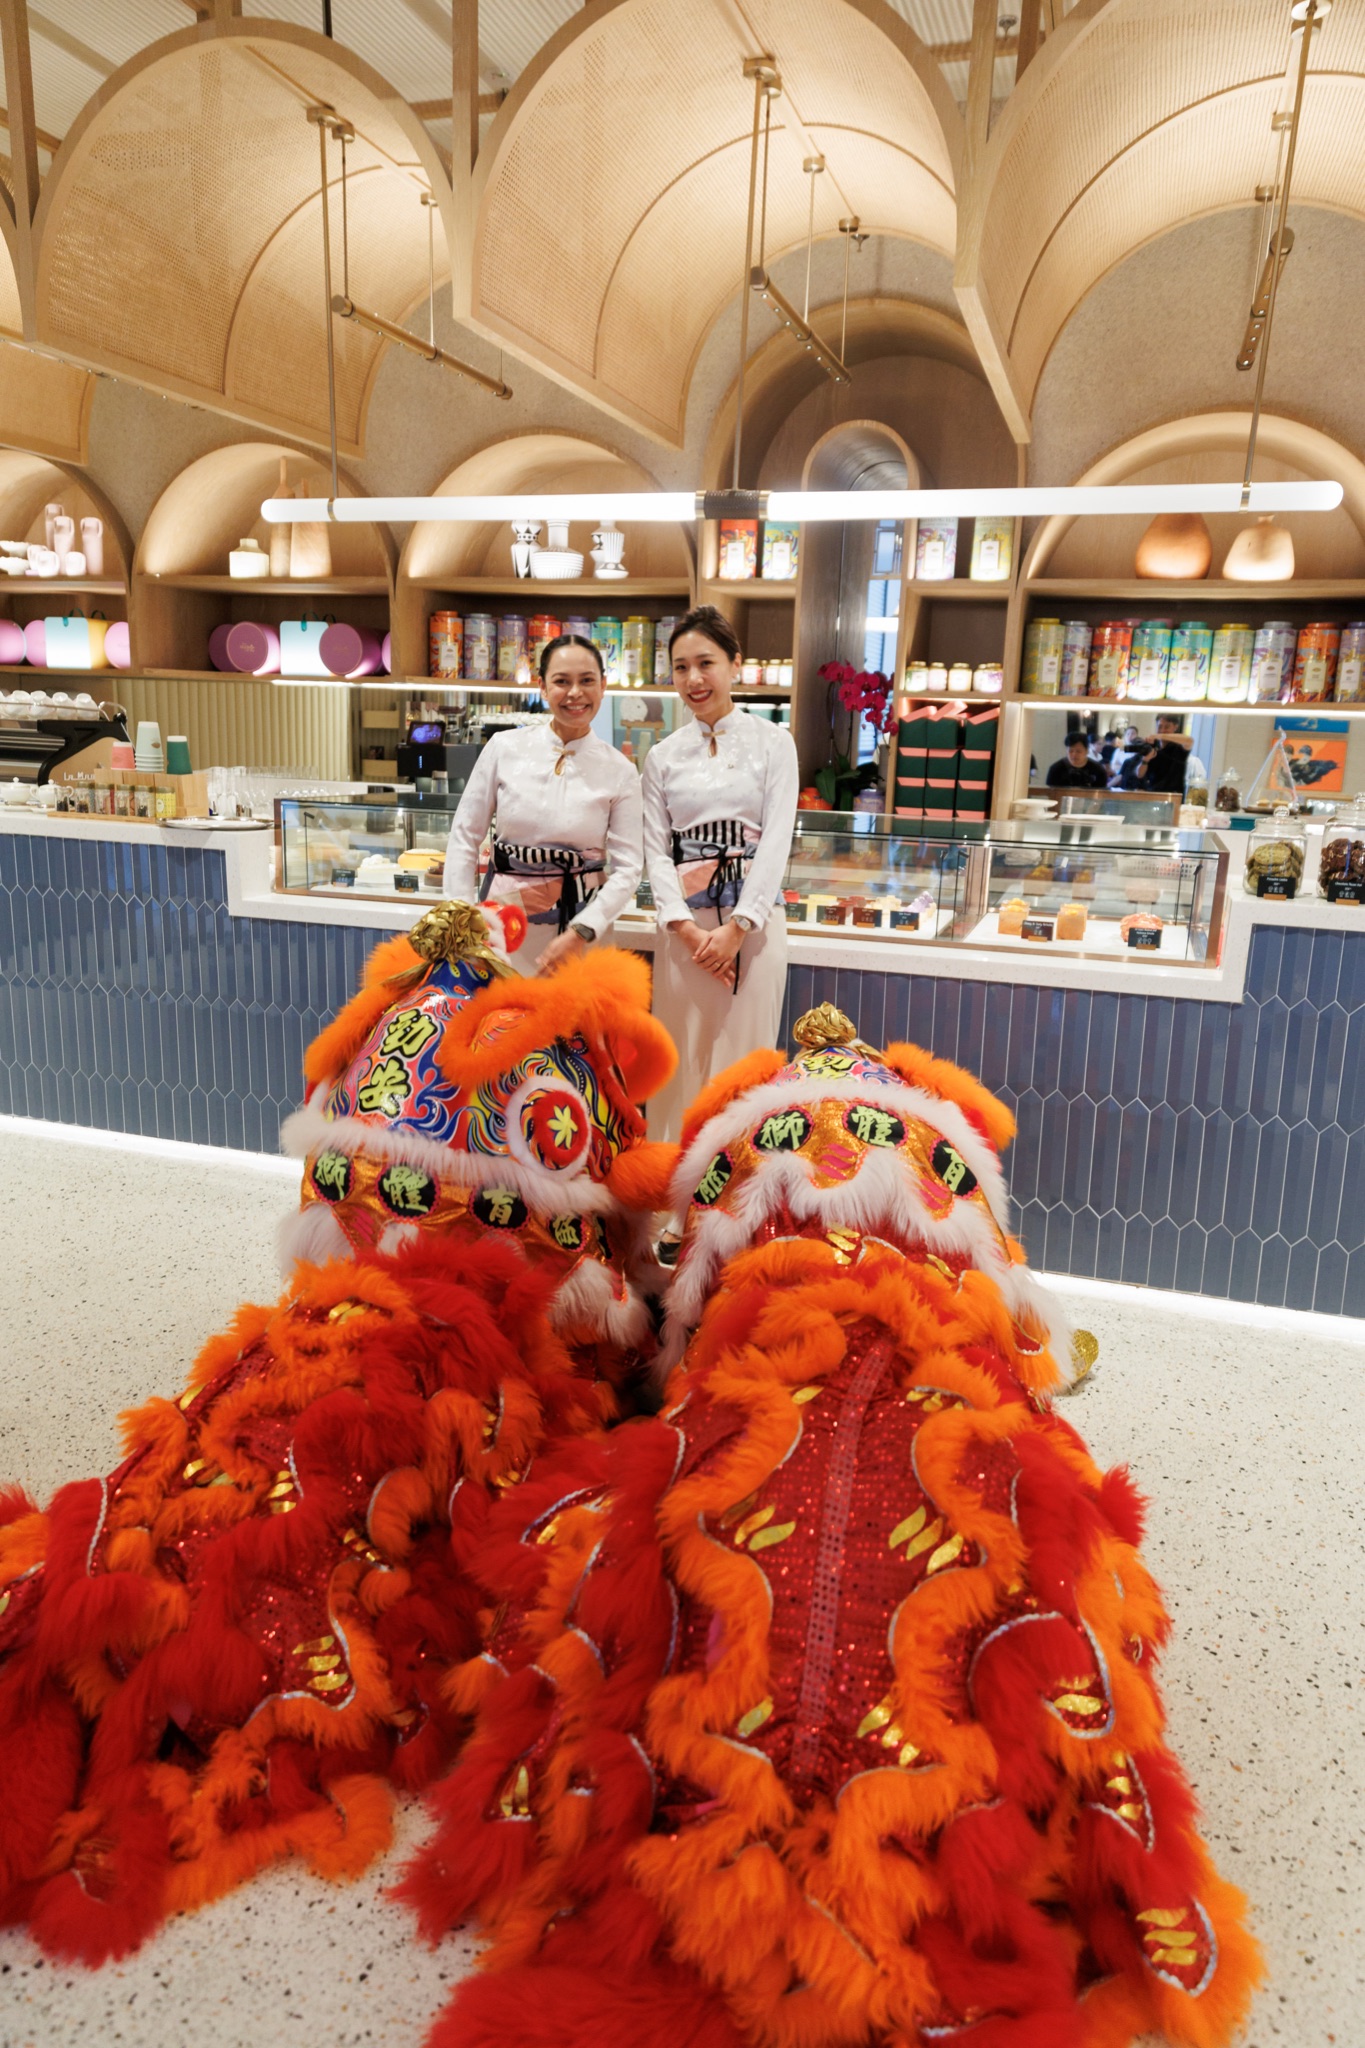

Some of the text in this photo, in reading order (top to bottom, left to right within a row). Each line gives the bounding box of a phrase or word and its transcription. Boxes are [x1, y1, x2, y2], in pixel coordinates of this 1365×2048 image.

[760, 1111, 805, 1151] 獅
[851, 1105, 898, 1147] 體
[383, 1165, 430, 1213] 體
[482, 1184, 518, 1225] 育
